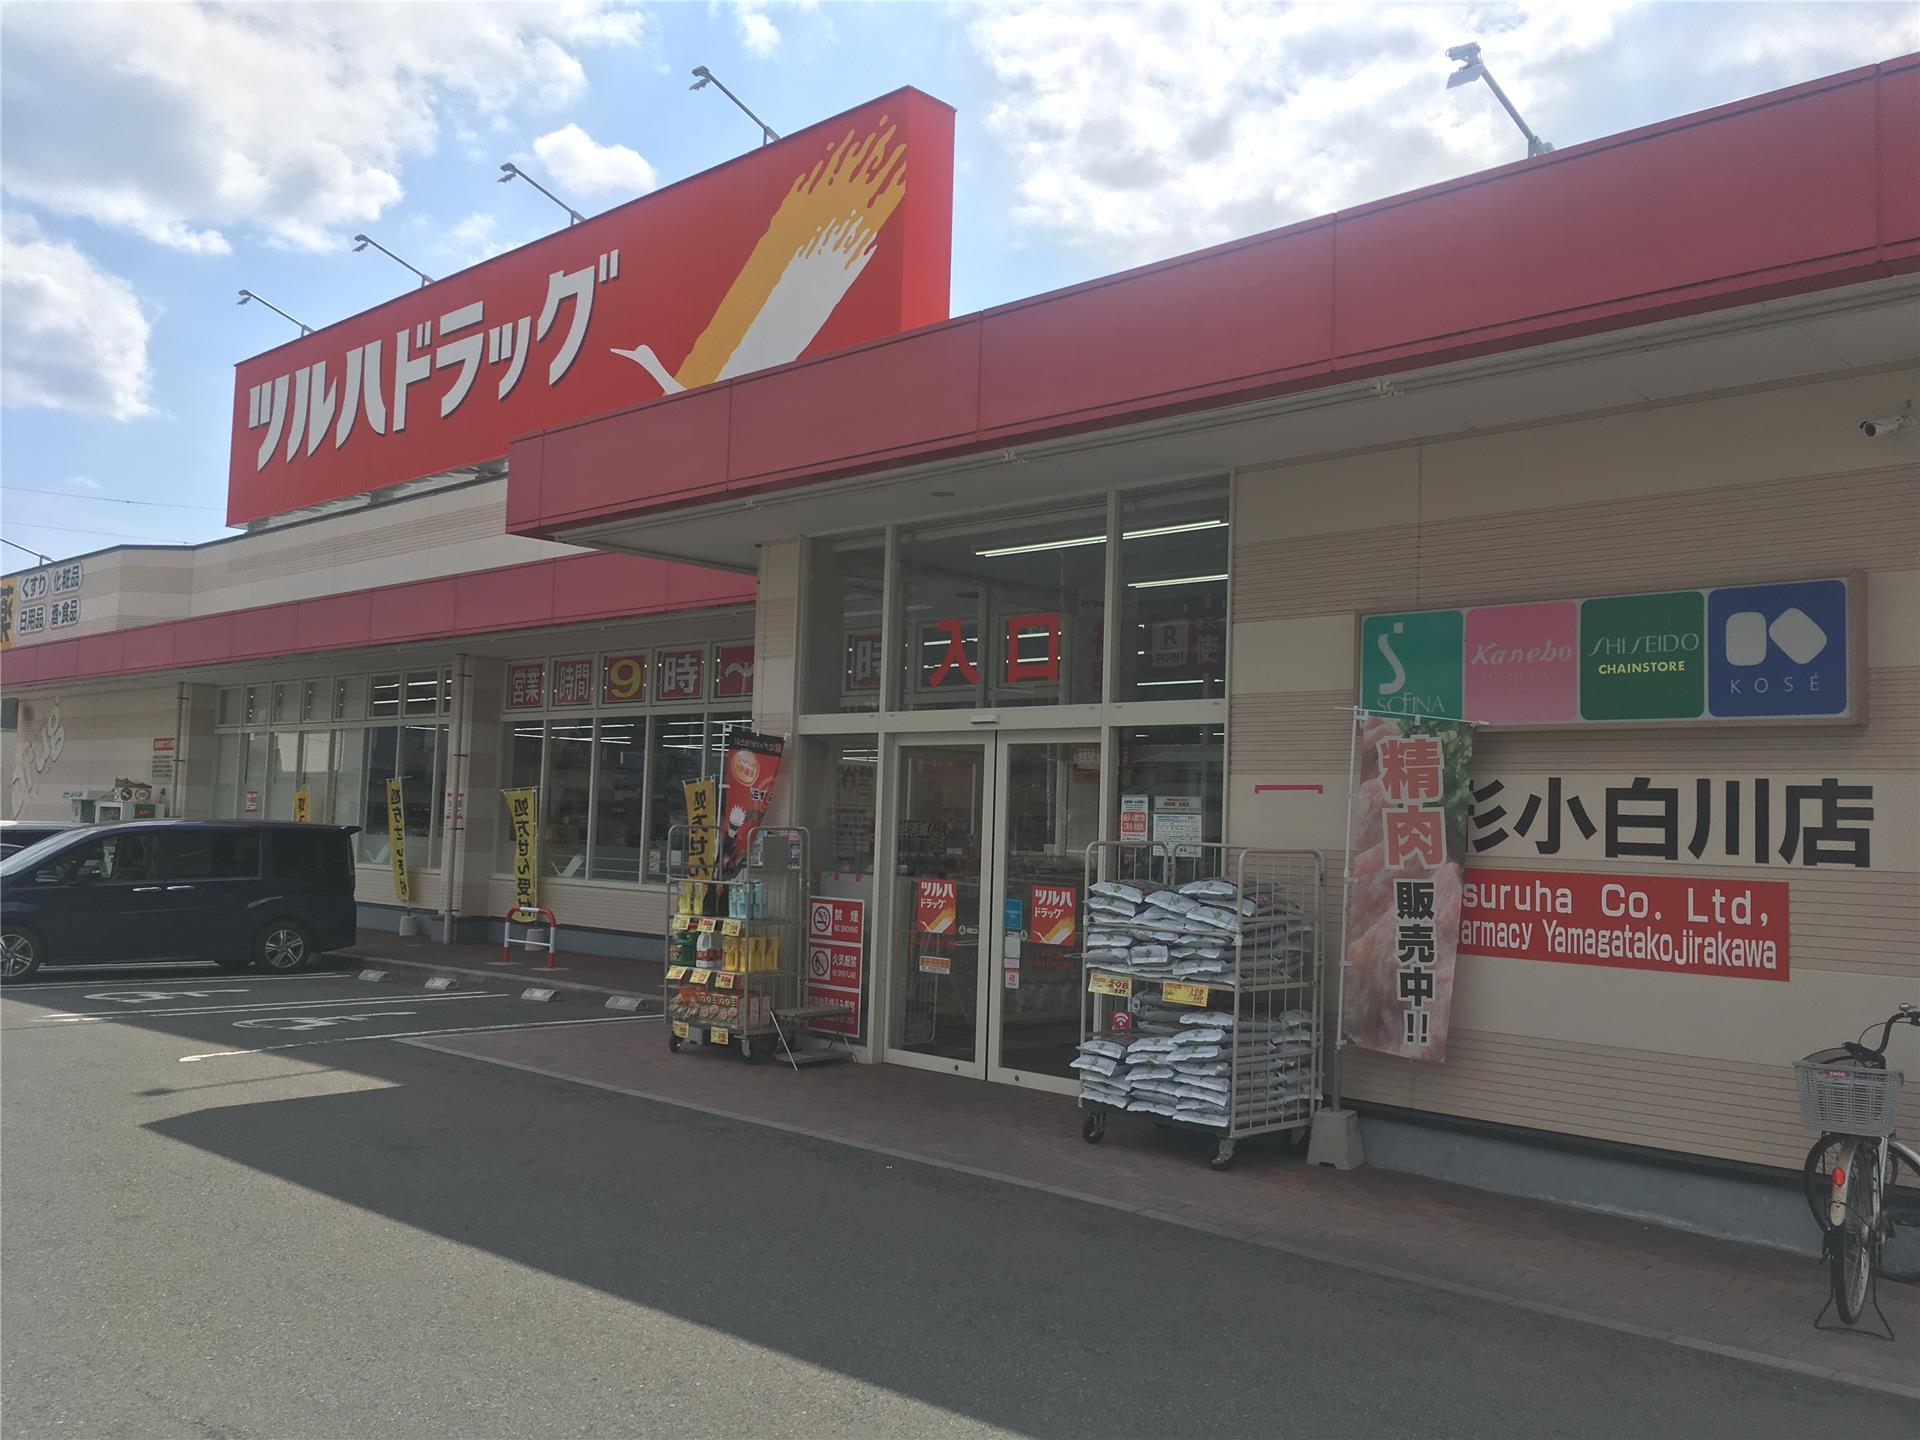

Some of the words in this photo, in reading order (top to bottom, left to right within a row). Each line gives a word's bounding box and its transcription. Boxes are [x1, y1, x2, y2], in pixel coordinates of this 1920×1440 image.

[248, 248, 620, 472] ツルハドラッグ
[22, 574, 46, 598] くすり
[53, 564, 80, 592] 化粧品
[19, 606, 44, 633] 日用品
[928, 612, 1060, 688] 入口
[1470, 640, 1573, 666] Kanebo
[1587, 632, 1700, 657] SHISEIDO
[1598, 660, 1687, 675] CHAINSTORE
[1729, 672, 1821, 695] KOSÉ
[1376, 691, 1446, 714] SOFINA
[920, 882, 954, 898] ツルハ
[1035, 889, 1073, 907] ツルハ
[1462, 879, 1574, 915] suruha
[1600, 883, 1662, 921] Co.
[920, 898, 947, 909] ドラッグ
[1034, 907, 1064, 919] ドラッグ
[1458, 920, 1533, 950] armacy
[1543, 919, 1777, 970] Yamagatakojirakawa
[1107, 979, 1129, 990] 298
